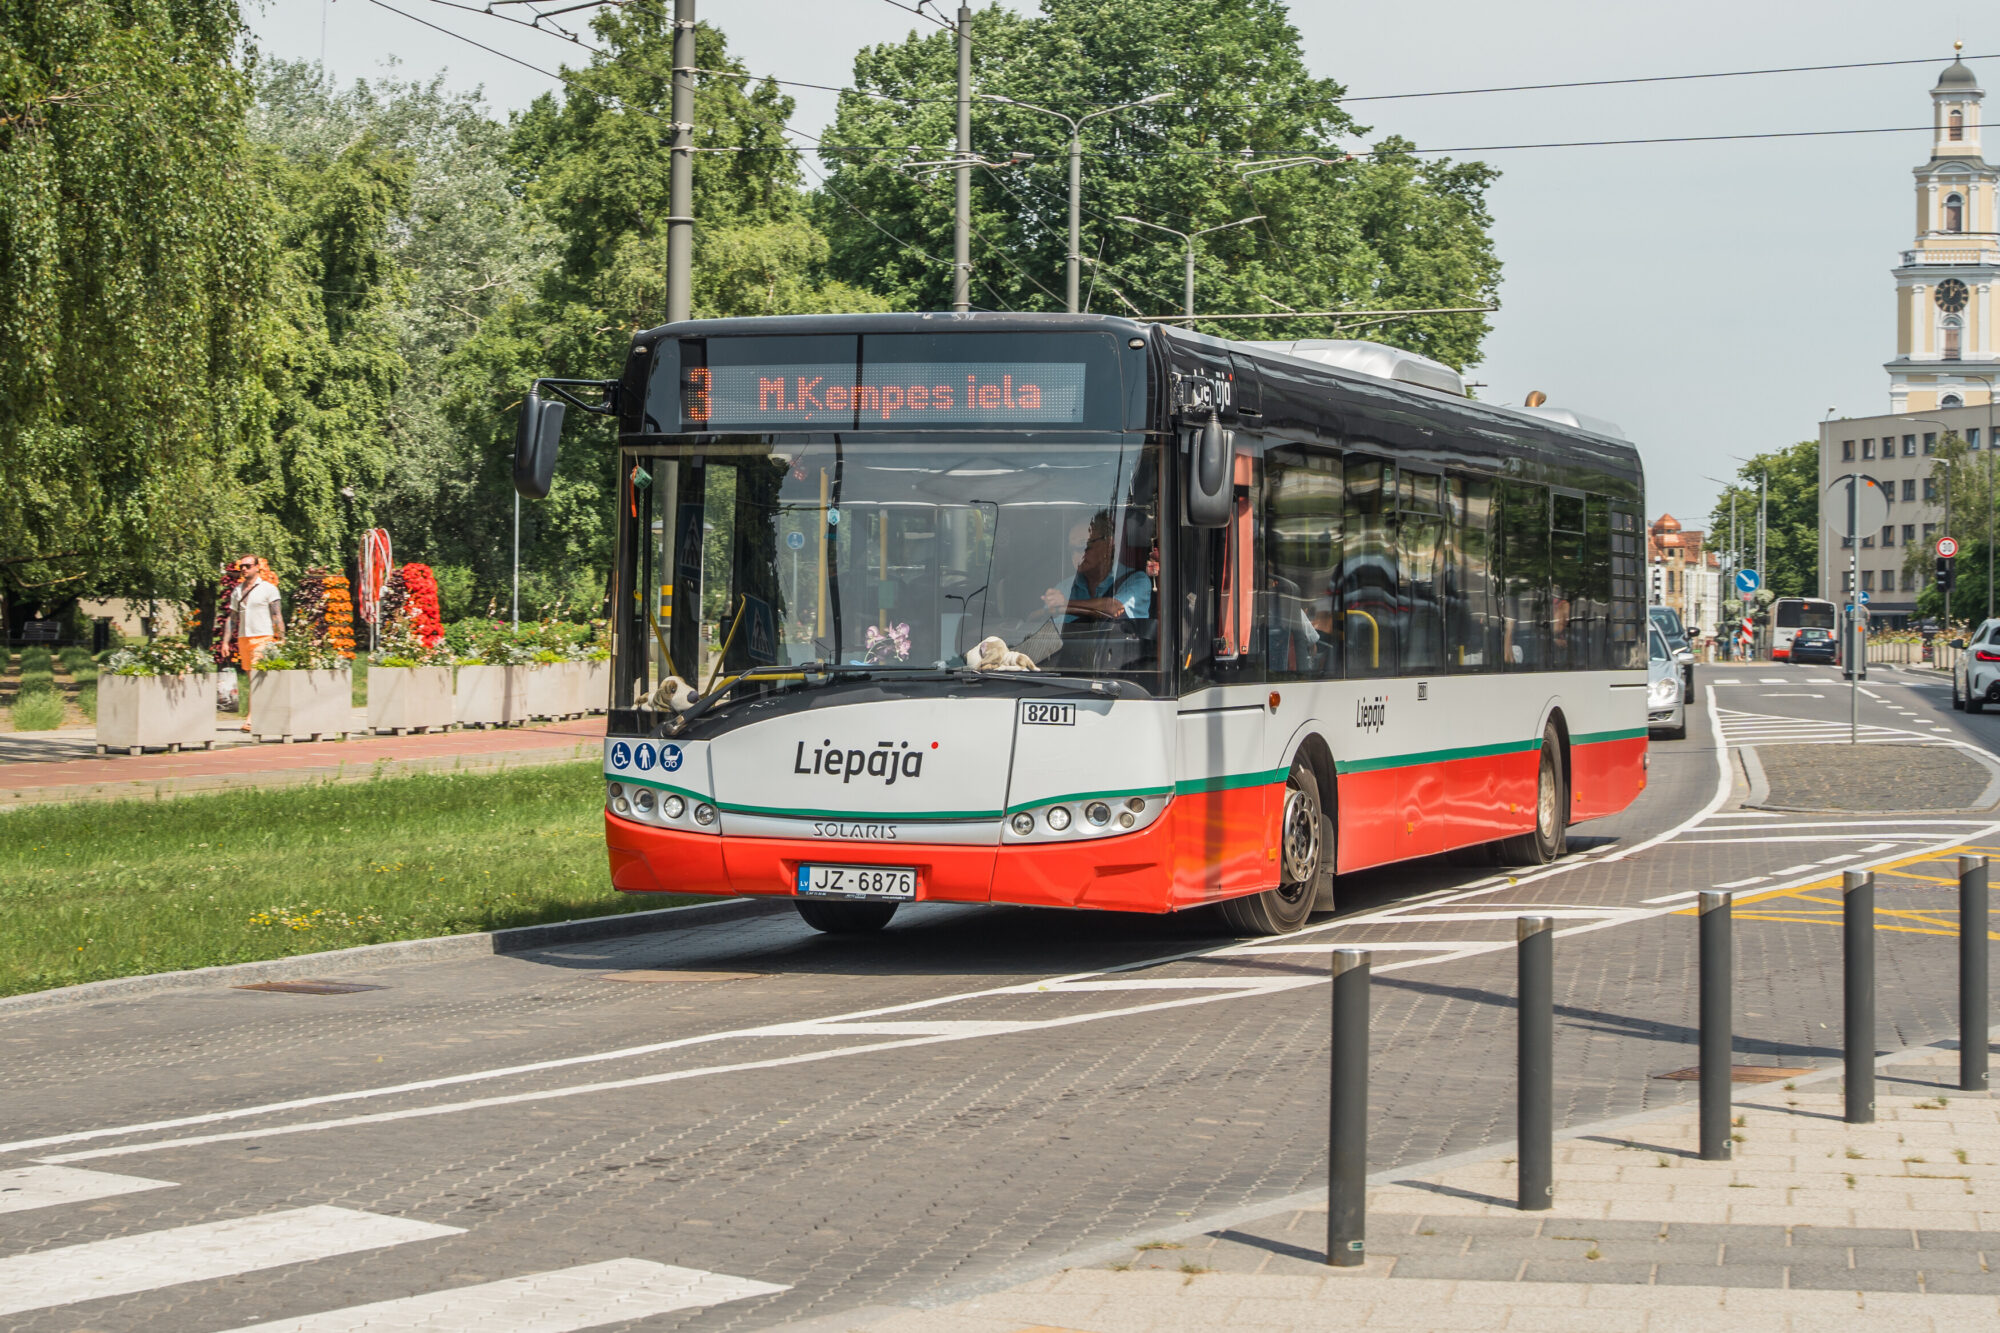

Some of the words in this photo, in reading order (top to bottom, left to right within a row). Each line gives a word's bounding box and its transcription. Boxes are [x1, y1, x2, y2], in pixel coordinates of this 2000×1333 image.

[690, 368, 712, 421] 3
[759, 376, 954, 421] M.Ķempes
[967, 374, 1041, 409] iela
[1193, 367, 1232, 413] iepāja
[1028, 704, 1069, 722] 8201
[1356, 696, 1386, 734] Liepāja
[794, 738, 924, 785] Liepāja
[813, 822, 898, 840] SOLARIS
[815, 869, 911, 893] JZ-6876
